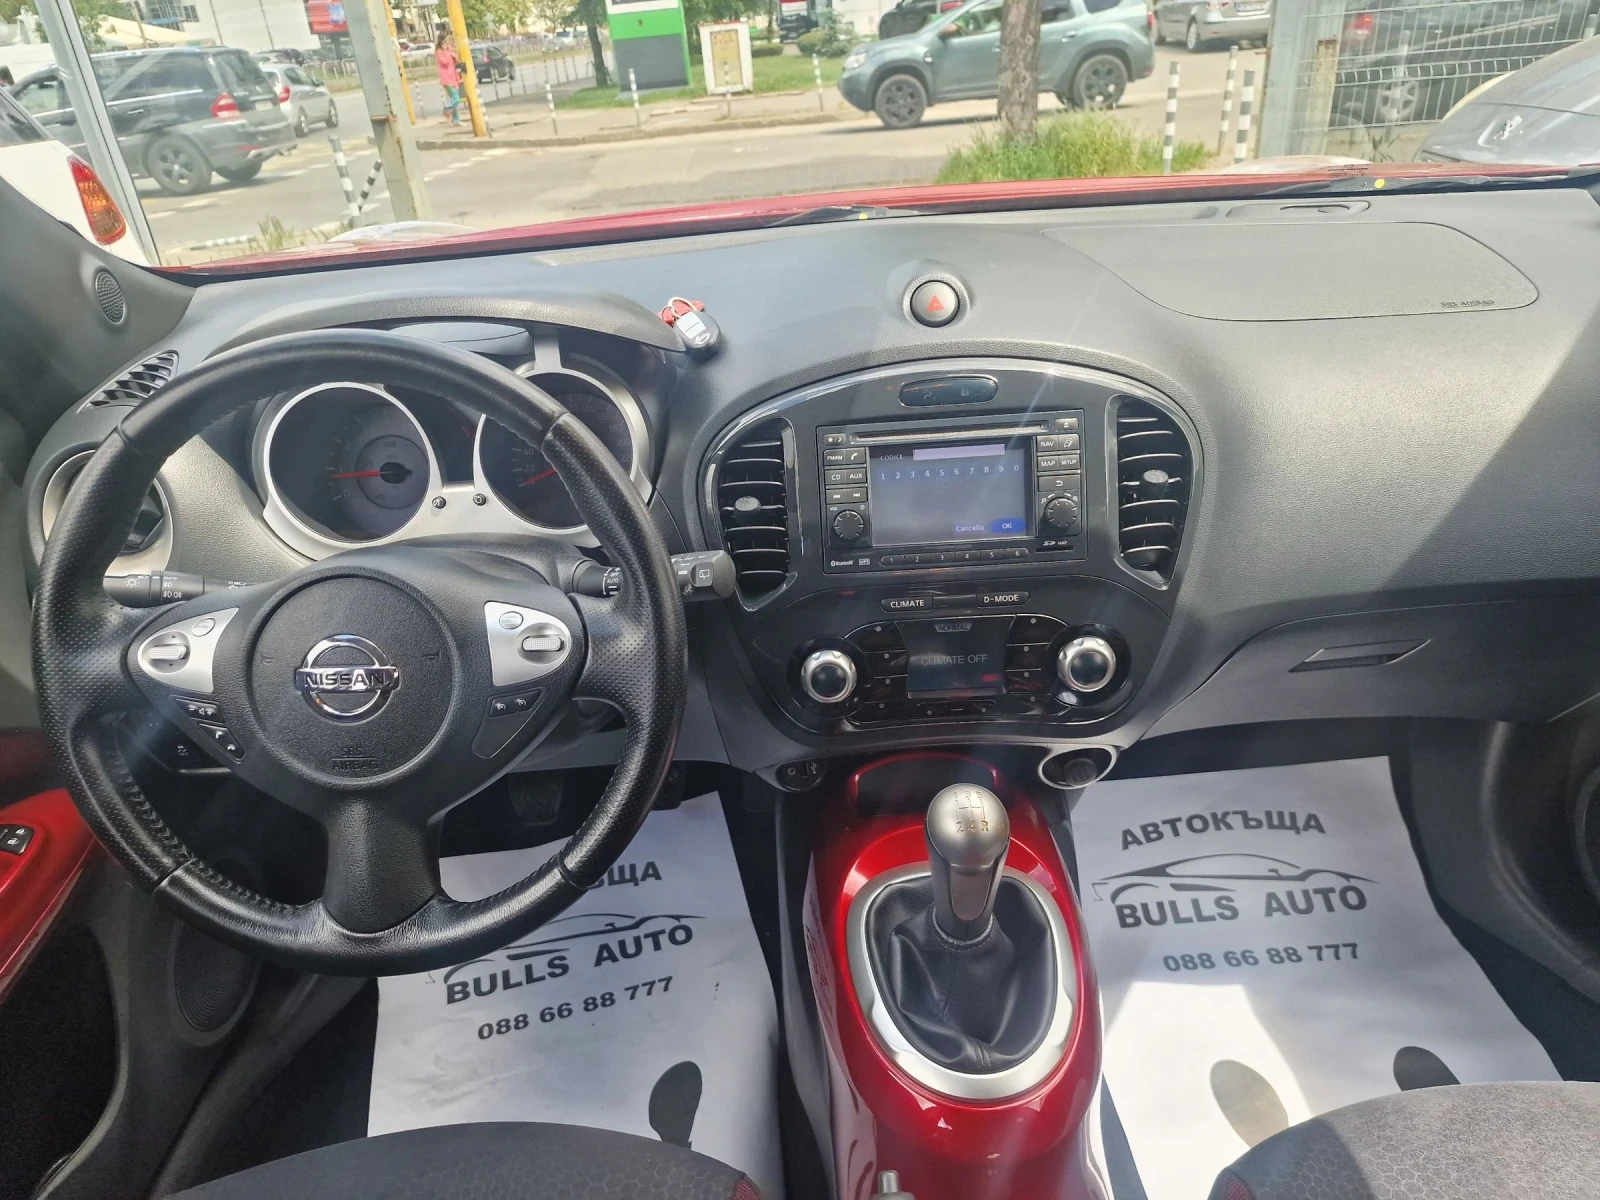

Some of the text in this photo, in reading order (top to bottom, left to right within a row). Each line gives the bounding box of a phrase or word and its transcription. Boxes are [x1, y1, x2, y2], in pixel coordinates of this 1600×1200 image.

[523, 448, 535, 456] 40
[524, 464, 536, 473] 20
[1013, 464, 1019, 472] 0
[956, 524, 985, 532] Cancella
[890, 600, 925, 608] CLIMATE
[983, 594, 1019, 603] D-MODE
[921, 653, 988, 665] CLIMATE OFF
[304, 672, 385, 687] NISSAN
[956, 820, 989, 832] 2 4 R
[1120, 809, 1326, 851] АВТОКЪЩА
[1114, 884, 1367, 929] BULLS AUTO
[1162, 942, 1359, 972] 088 66 88 777
[446, 923, 693, 1005] BULLS AUTO
[477, 975, 674, 1040] 088 66 88 777
